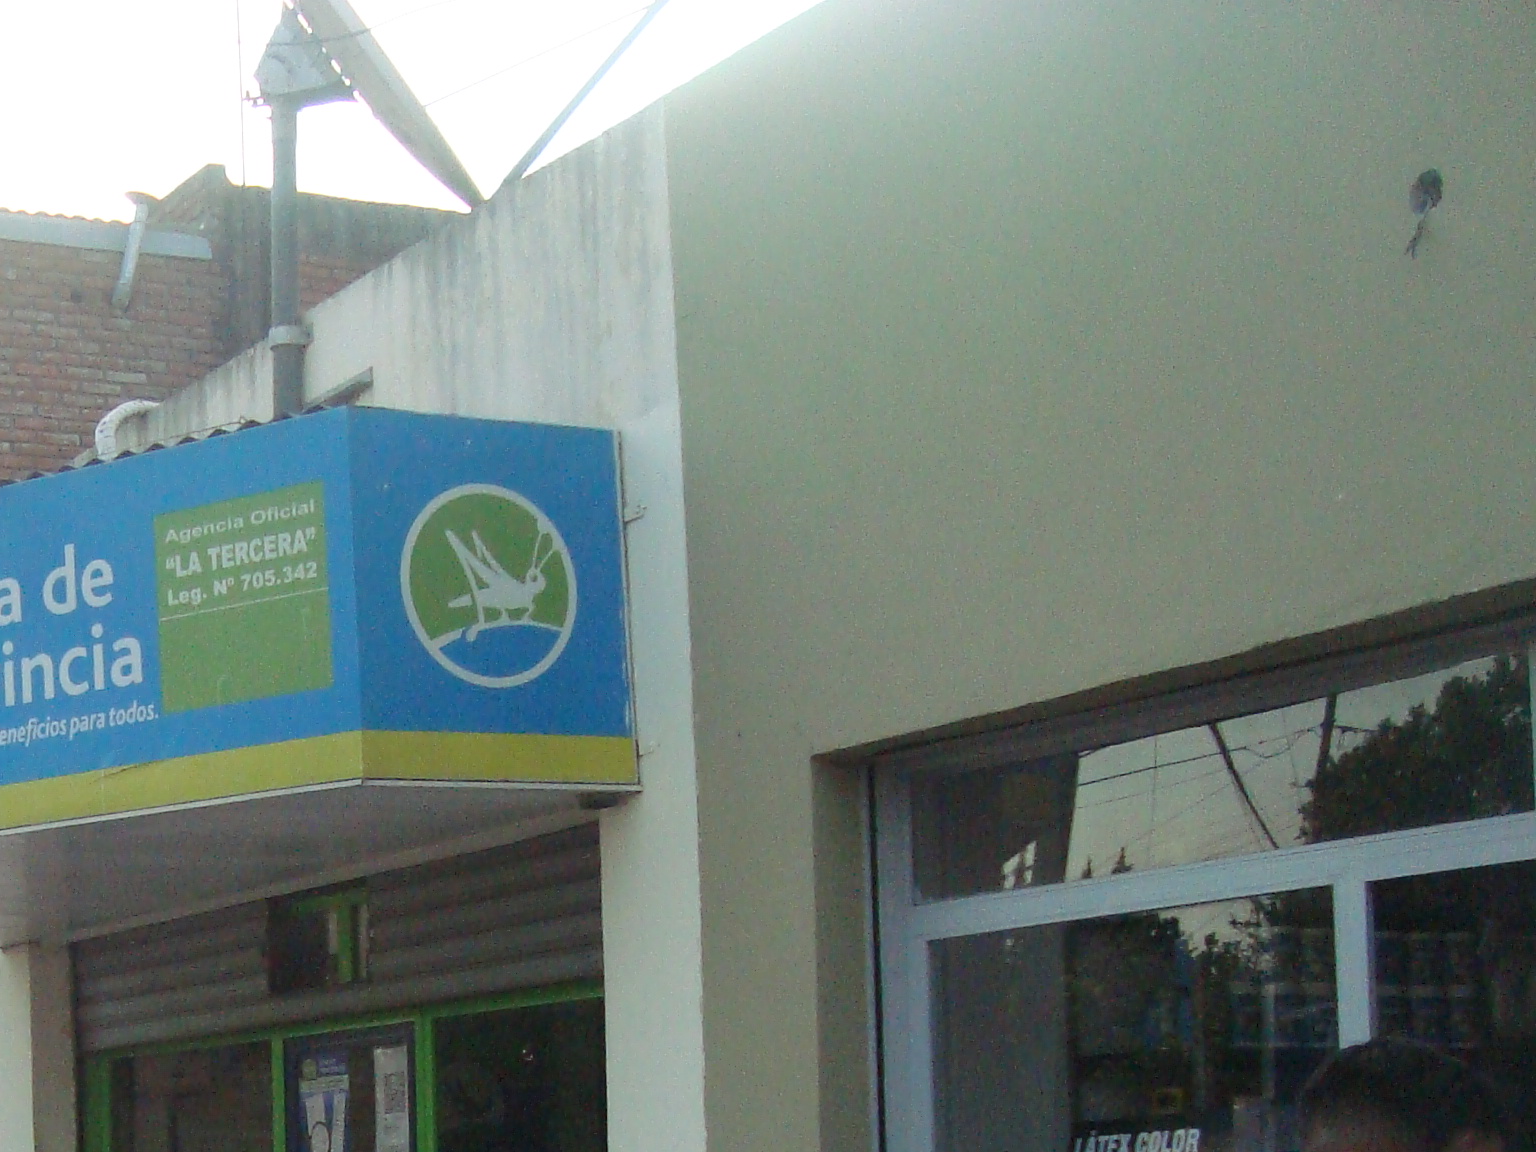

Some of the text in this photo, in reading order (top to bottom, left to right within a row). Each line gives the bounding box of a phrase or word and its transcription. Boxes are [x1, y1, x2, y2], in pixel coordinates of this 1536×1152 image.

[165, 498, 315, 543] Agencia Oficial
[42, 543, 114, 615] de
[167, 587, 208, 607] Leg.
[239, 561, 318, 592] 705.342
[69, 709, 106, 741] para
[109, 699, 160, 727] todos.
